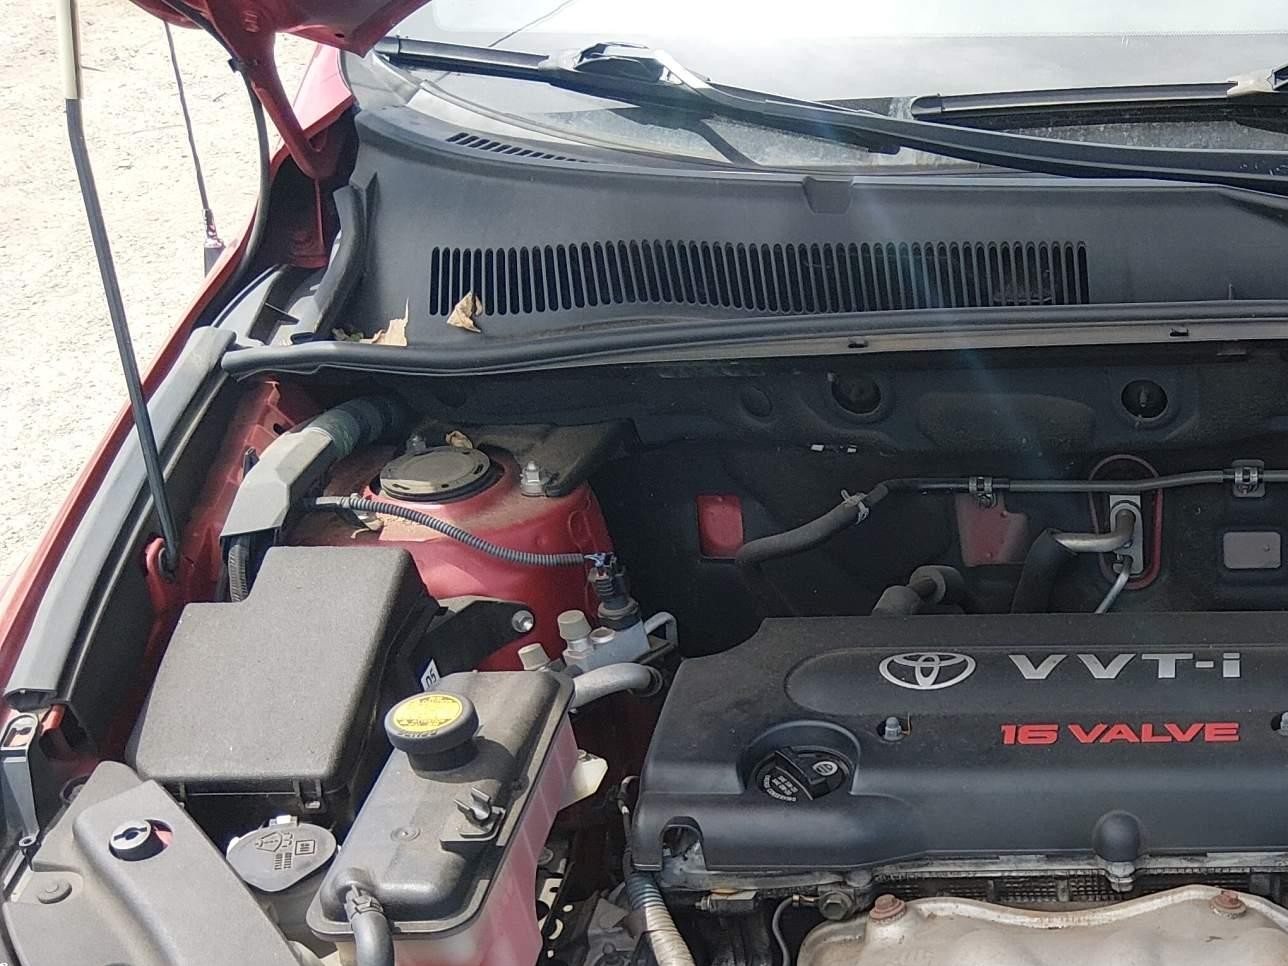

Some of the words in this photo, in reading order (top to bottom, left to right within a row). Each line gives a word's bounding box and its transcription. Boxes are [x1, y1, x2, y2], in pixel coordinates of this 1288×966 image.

[1007, 653, 1240, 680] VVT-i
[1000, 724, 1059, 745] 16
[1067, 723, 1240, 744] VALVE
